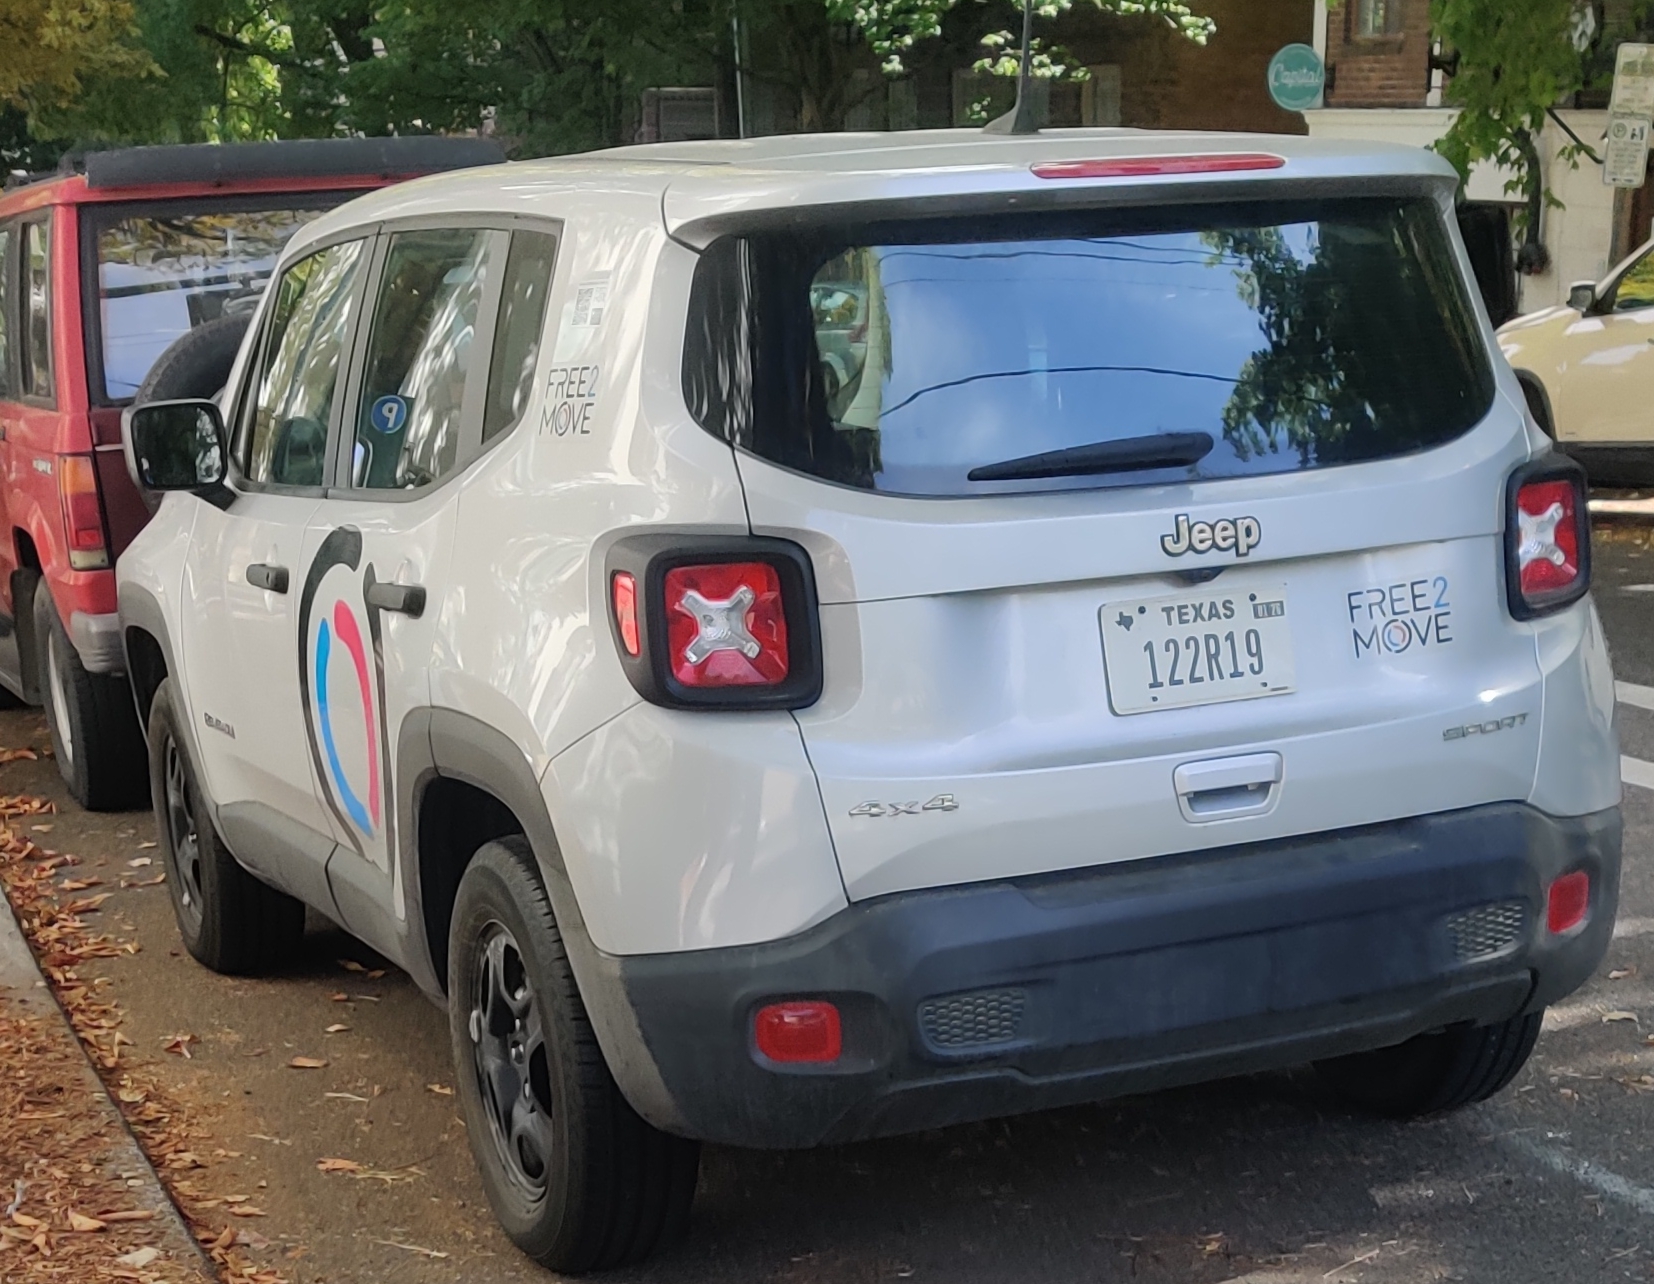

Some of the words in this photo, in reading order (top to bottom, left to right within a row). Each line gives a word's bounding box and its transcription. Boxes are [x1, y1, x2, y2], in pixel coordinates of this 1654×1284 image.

[545, 365, 599, 399] FREE2
[539, 401, 594, 437] MOVE
[1160, 513, 1261, 557] Jeep
[1161, 599, 1235, 626] TEXAS
[1347, 576, 1450, 624] FREE2
[1353, 611, 1453, 659] MOVE
[1143, 628, 1264, 689] 122R19
[1442, 712, 1529, 742] SPORT
